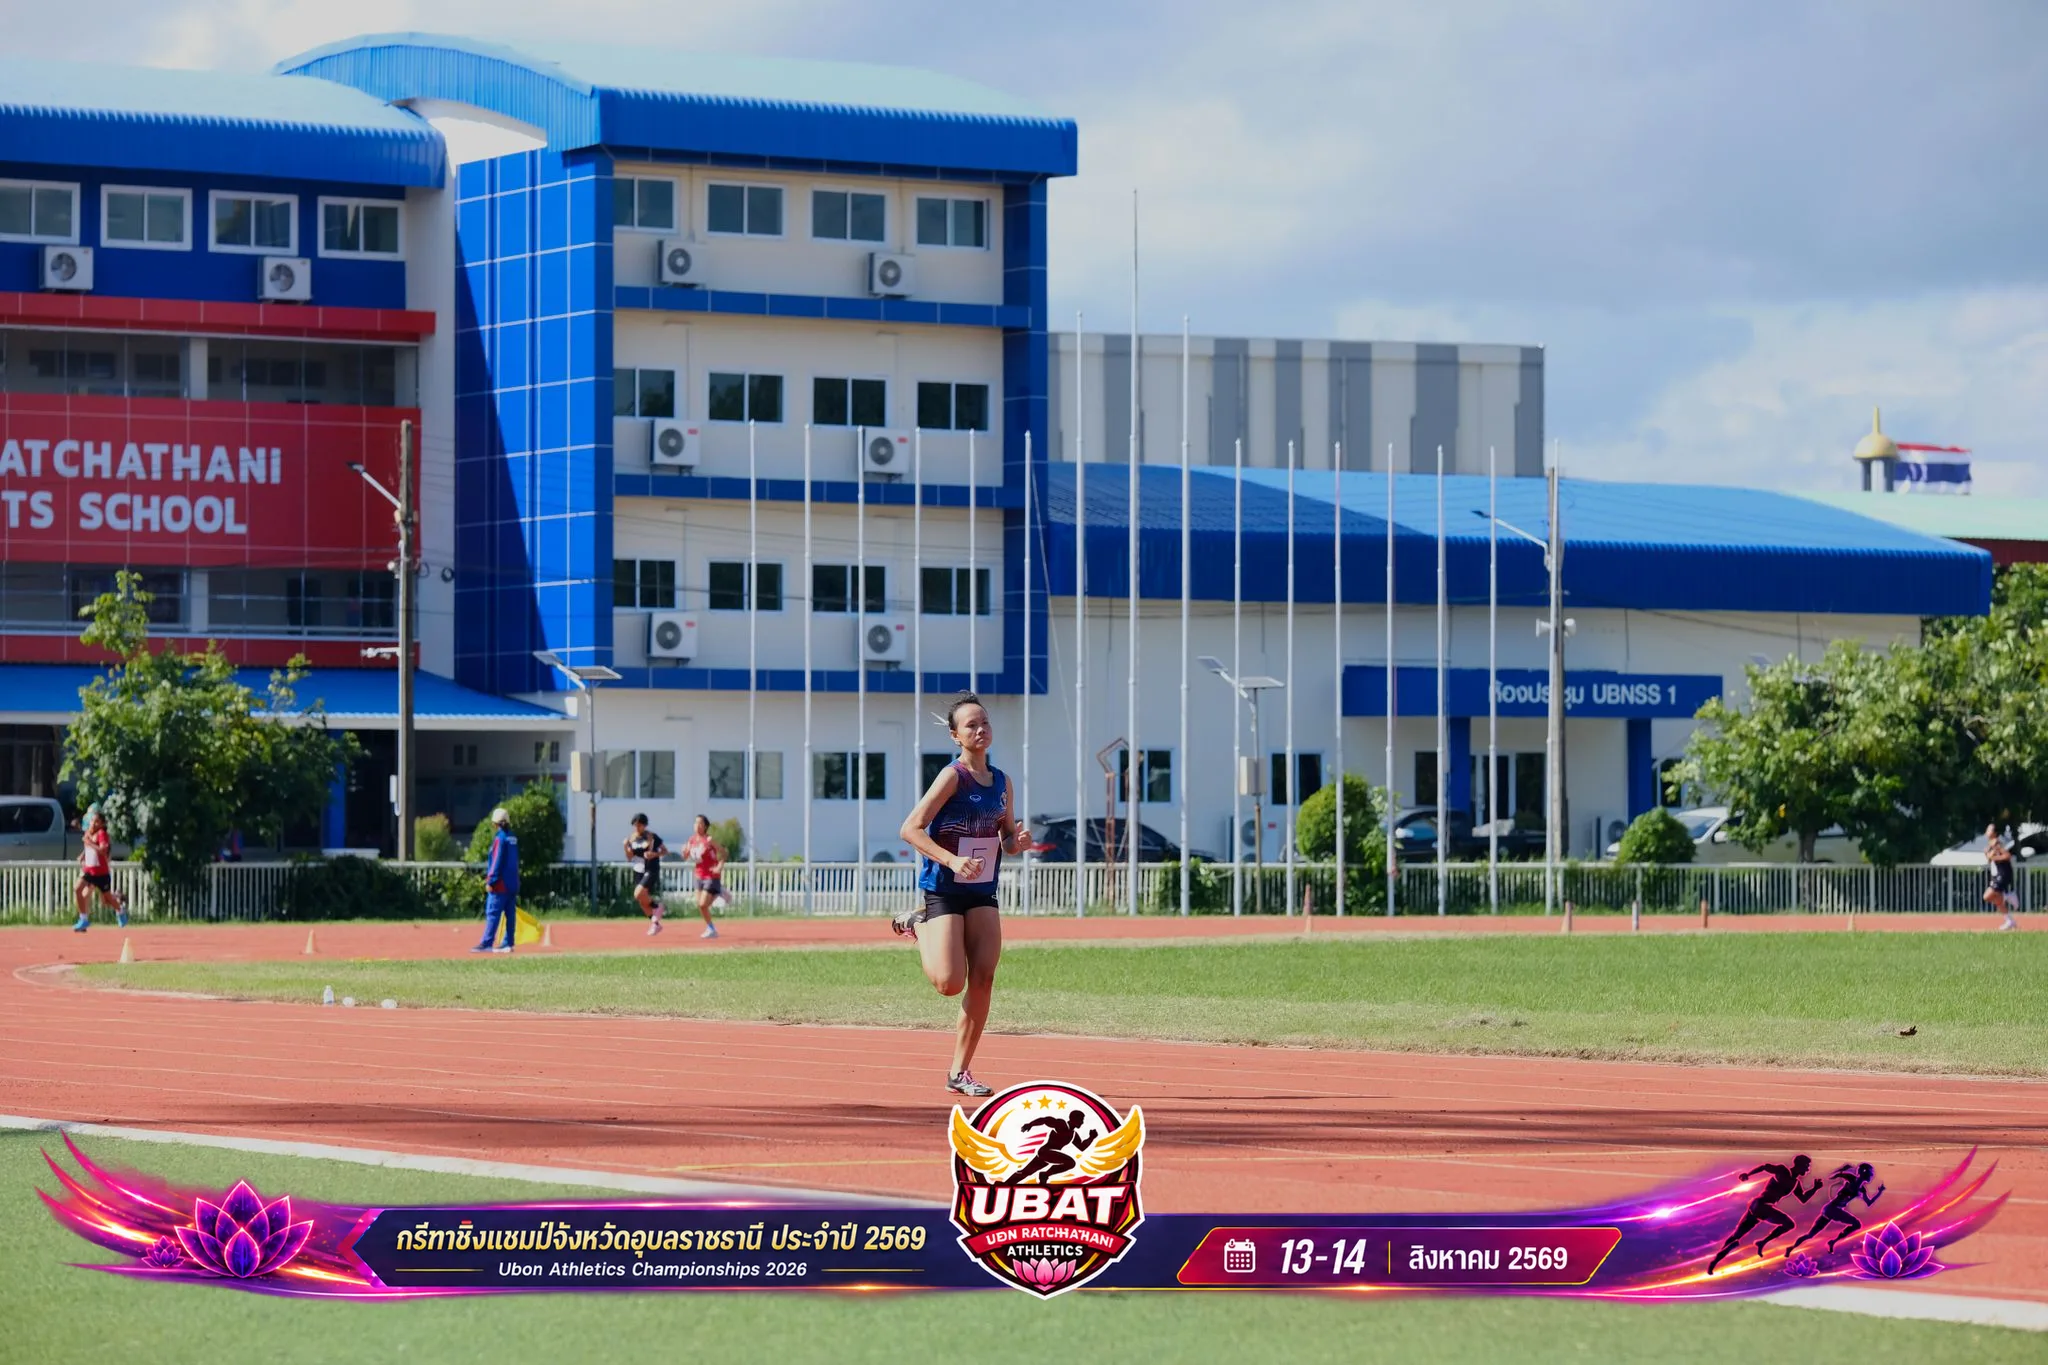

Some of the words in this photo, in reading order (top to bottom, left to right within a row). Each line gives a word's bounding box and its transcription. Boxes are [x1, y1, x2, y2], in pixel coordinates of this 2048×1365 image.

[0, 438, 281, 484] ATCHATHANI
[79, 491, 248, 534] SCHOOL
[1593, 683, 1662, 705] UBNSS
[1667, 685, 1676, 705] 1
